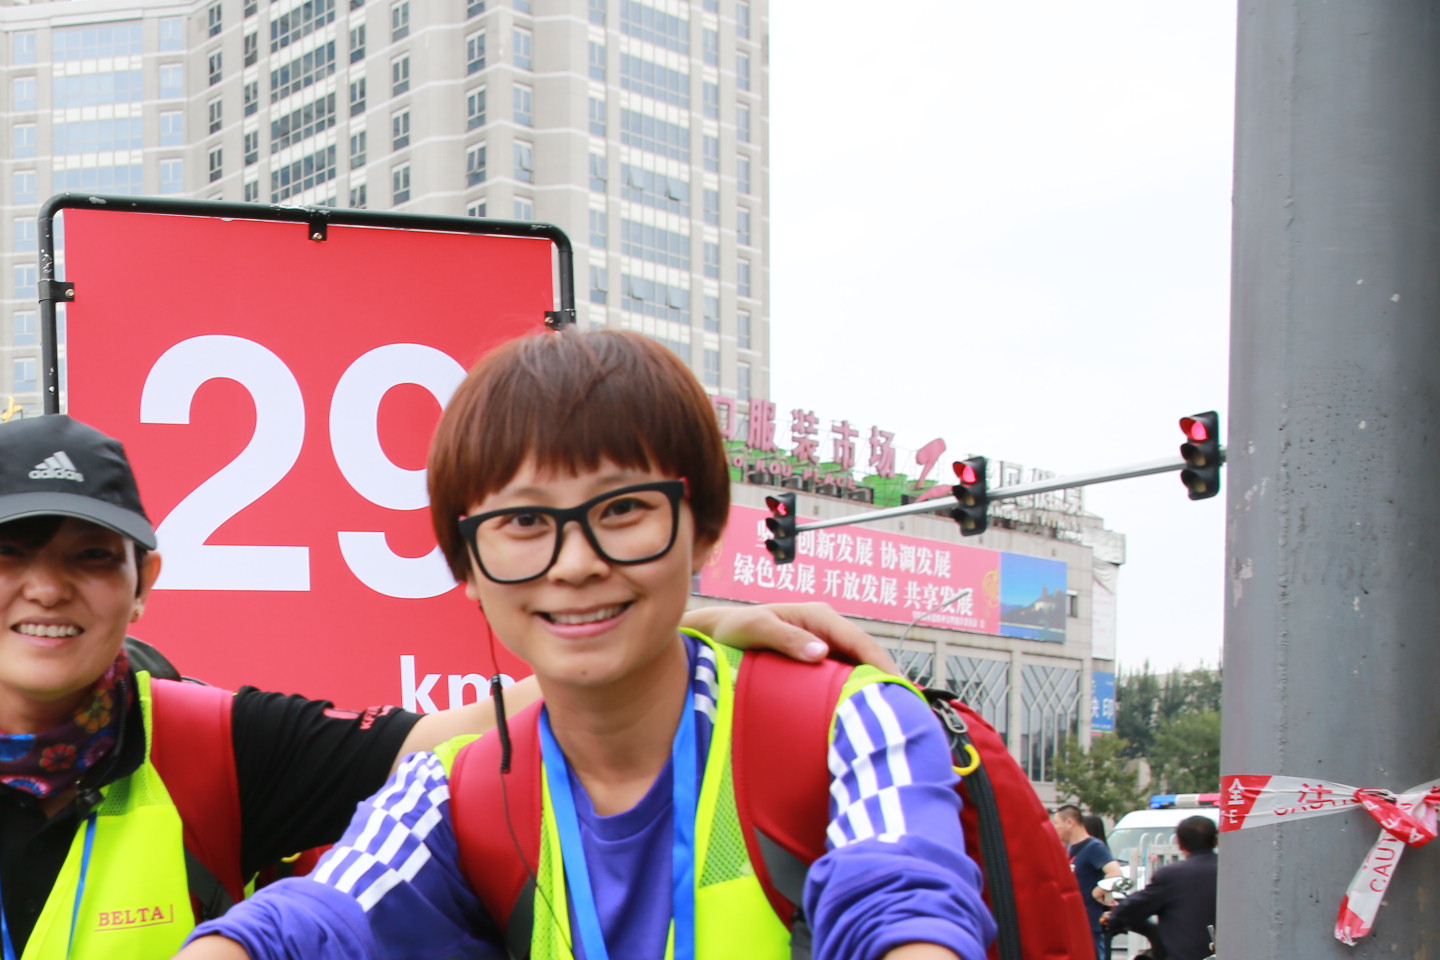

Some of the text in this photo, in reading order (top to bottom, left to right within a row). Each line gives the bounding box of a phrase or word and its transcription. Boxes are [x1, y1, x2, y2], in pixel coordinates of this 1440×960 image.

[28, 469, 84, 482] adidas
[139, 334, 468, 600] 29
[802, 468, 857, 489] PLACE
[879, 541, 952, 579] 协调发展
[732, 553, 974, 617] 绿色发展 开放发展 共享发展
[400, 654, 517, 715] km
[98, 906, 165, 927] BELTA
